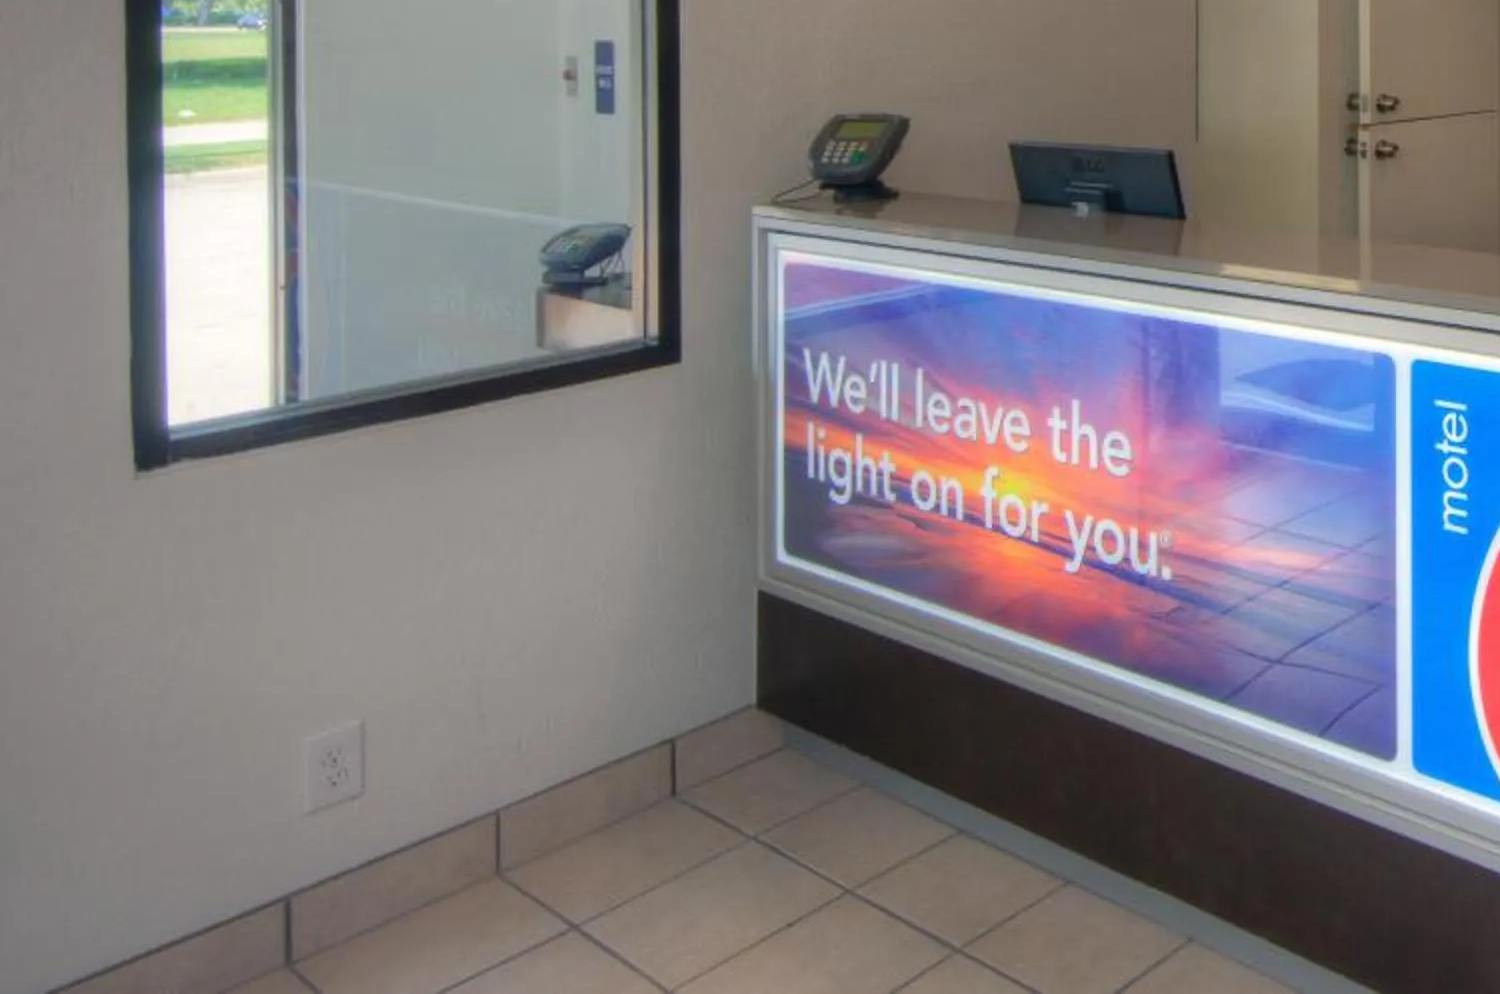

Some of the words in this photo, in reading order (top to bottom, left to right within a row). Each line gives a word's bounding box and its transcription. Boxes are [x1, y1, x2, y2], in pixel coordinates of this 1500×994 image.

[803, 347, 900, 422] We'll
[915, 367, 1032, 453] leave
[1047, 399, 1133, 477] the
[1433, 398, 1469, 535] motel
[806, 420, 897, 505] light
[910, 469, 964, 522] on
[980, 466, 1050, 543] for
